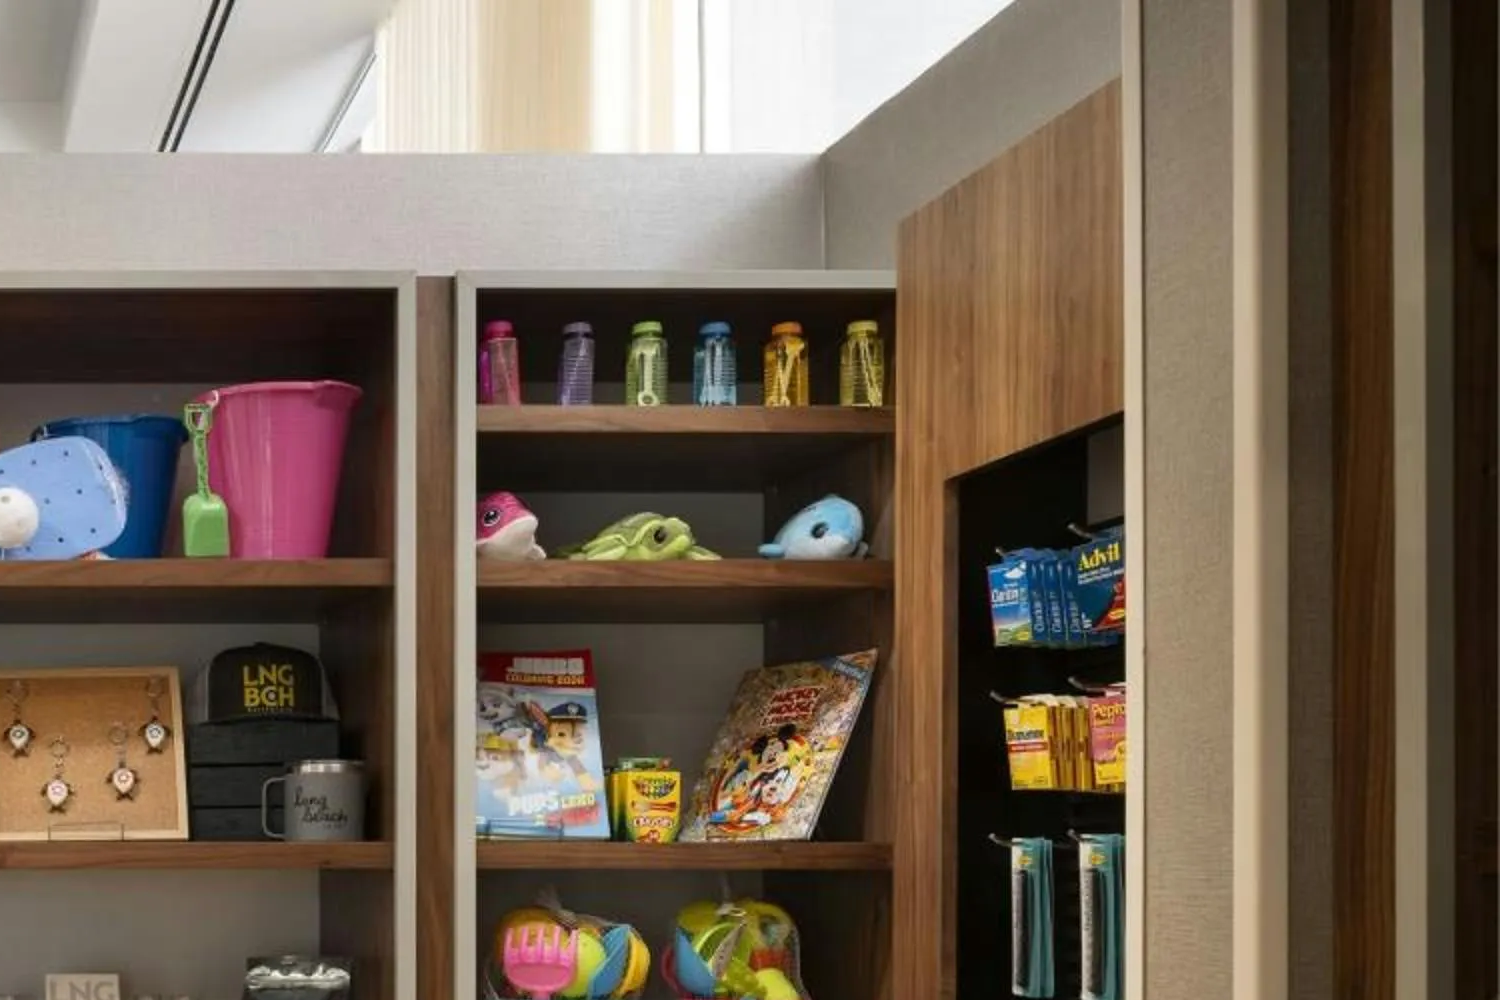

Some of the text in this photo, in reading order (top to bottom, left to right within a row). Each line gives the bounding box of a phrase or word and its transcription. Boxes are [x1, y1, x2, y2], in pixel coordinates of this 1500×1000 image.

[1077, 543, 1120, 571] Advil
[243, 664, 294, 686] LNG
[243, 686, 295, 707] BCH
